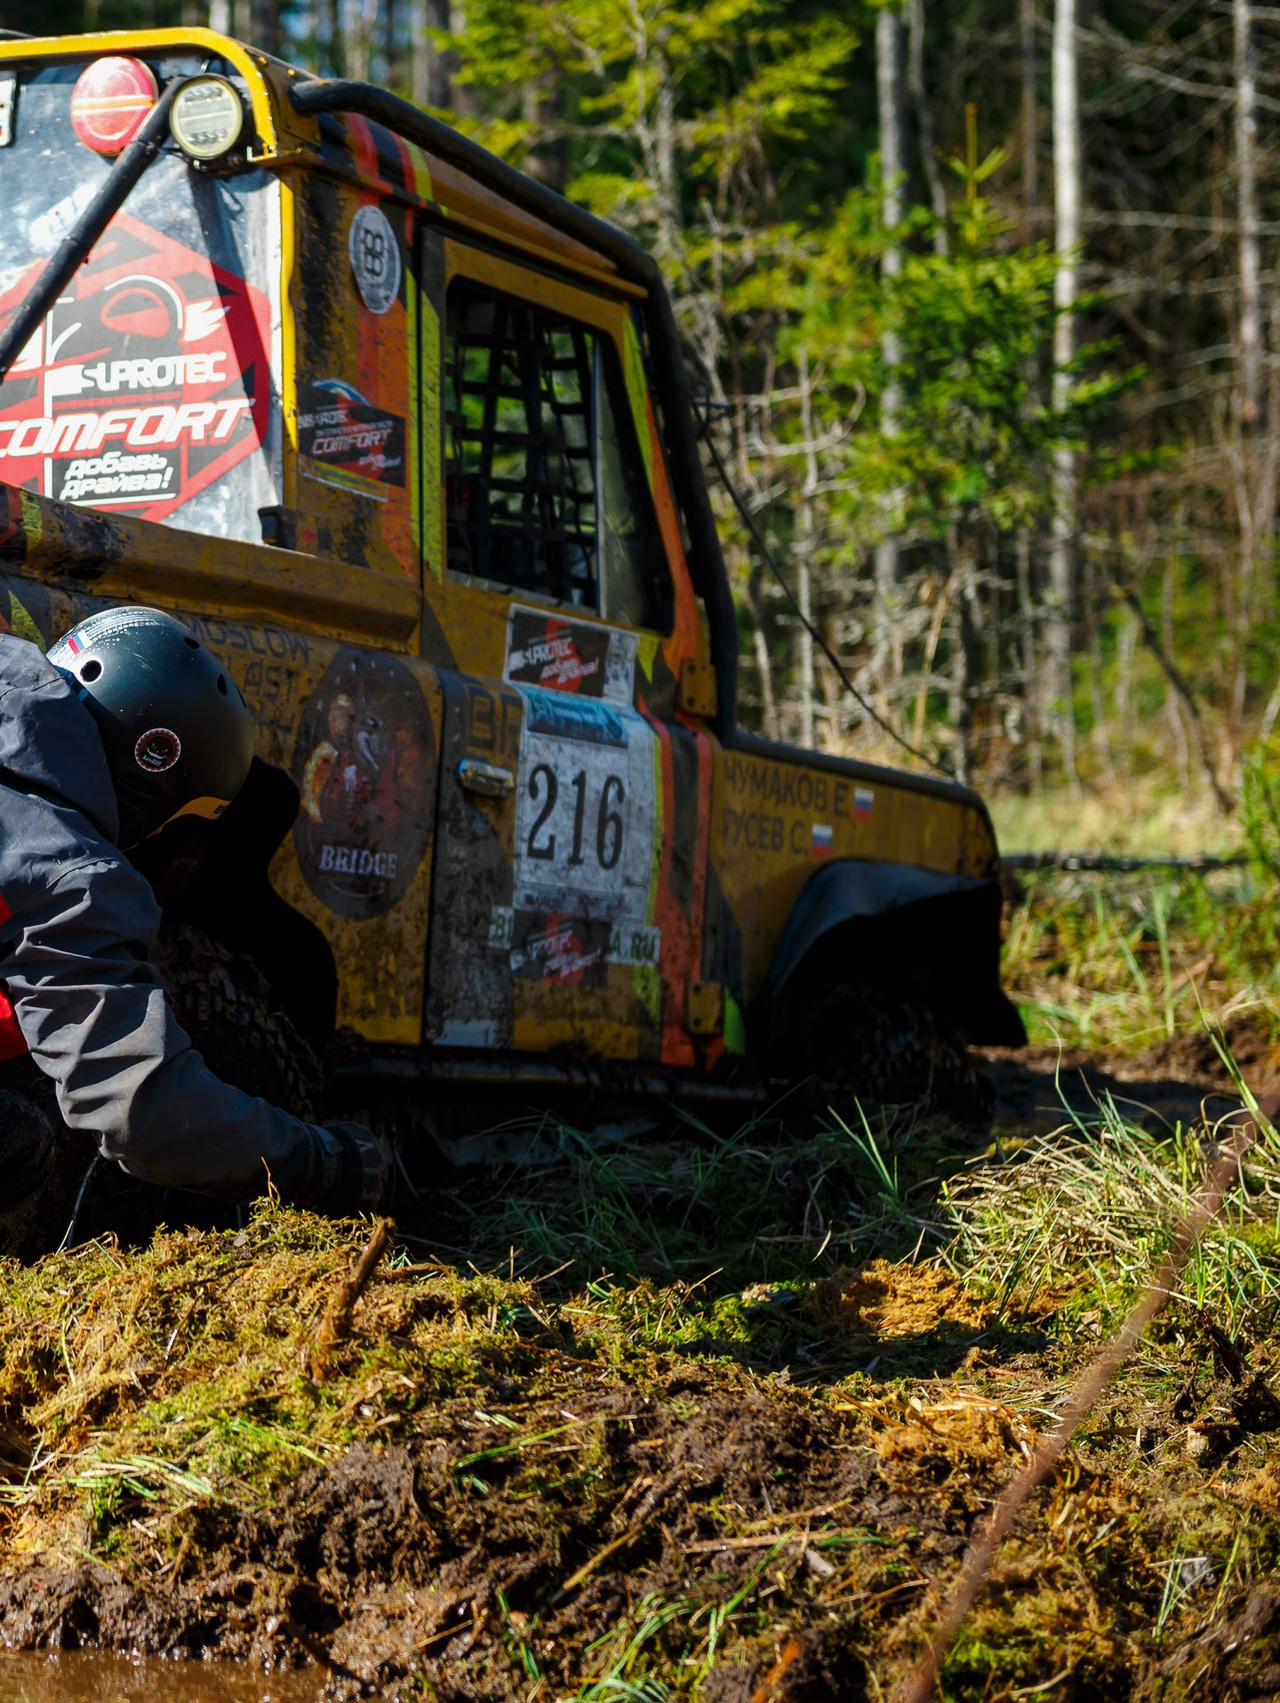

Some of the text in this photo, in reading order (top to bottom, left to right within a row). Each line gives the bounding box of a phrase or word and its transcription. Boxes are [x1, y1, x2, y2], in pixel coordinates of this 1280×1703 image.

[81, 351, 227, 392] SUPROTEC
[527, 763, 625, 871] 216
[319, 844, 397, 879] BRIDGE
